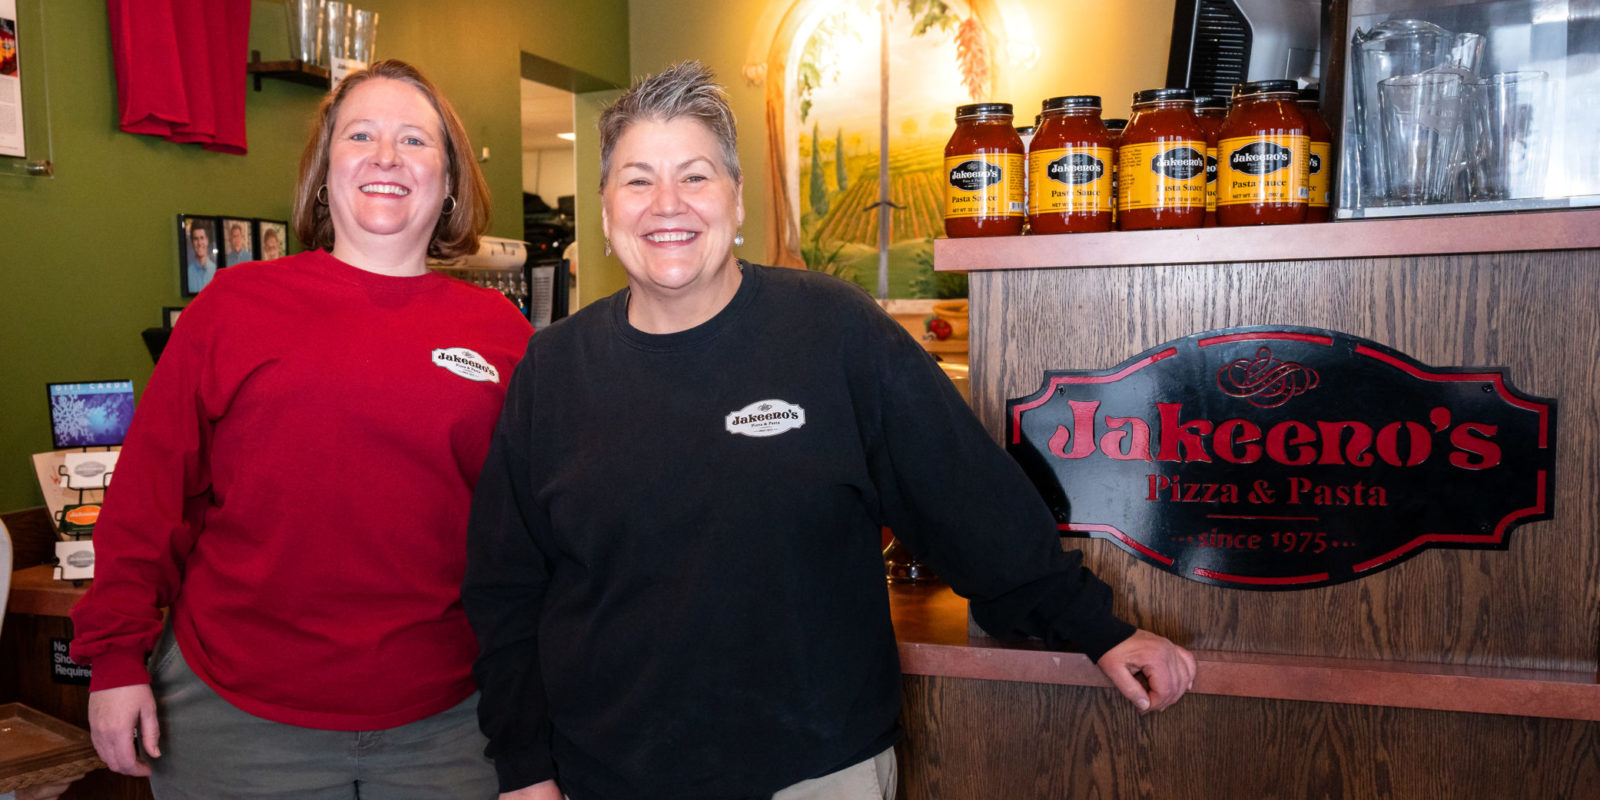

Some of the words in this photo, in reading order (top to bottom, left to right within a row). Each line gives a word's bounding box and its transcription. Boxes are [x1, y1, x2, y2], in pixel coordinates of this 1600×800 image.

[1157, 157, 1204, 168] Jakeeno's
[1233, 152, 1288, 162] Jakeeno's
[1051, 164, 1102, 173] Jakeeno's
[952, 169, 998, 180] Jakeeno's
[1232, 180, 1256, 188] Pasta
[1259, 179, 1287, 188] auce
[952, 196, 970, 204] Pasta
[438, 352, 495, 376] Jakeeno's
[732, 409, 799, 426] Jakeeno's
[1048, 400, 1502, 470] Jakeeno's
[1145, 474, 1238, 504] Pizza
[1247, 479, 1276, 504] &
[1286, 476, 1388, 506] Pasta
[53, 641, 67, 652] No
[54, 653, 76, 664] Sho
